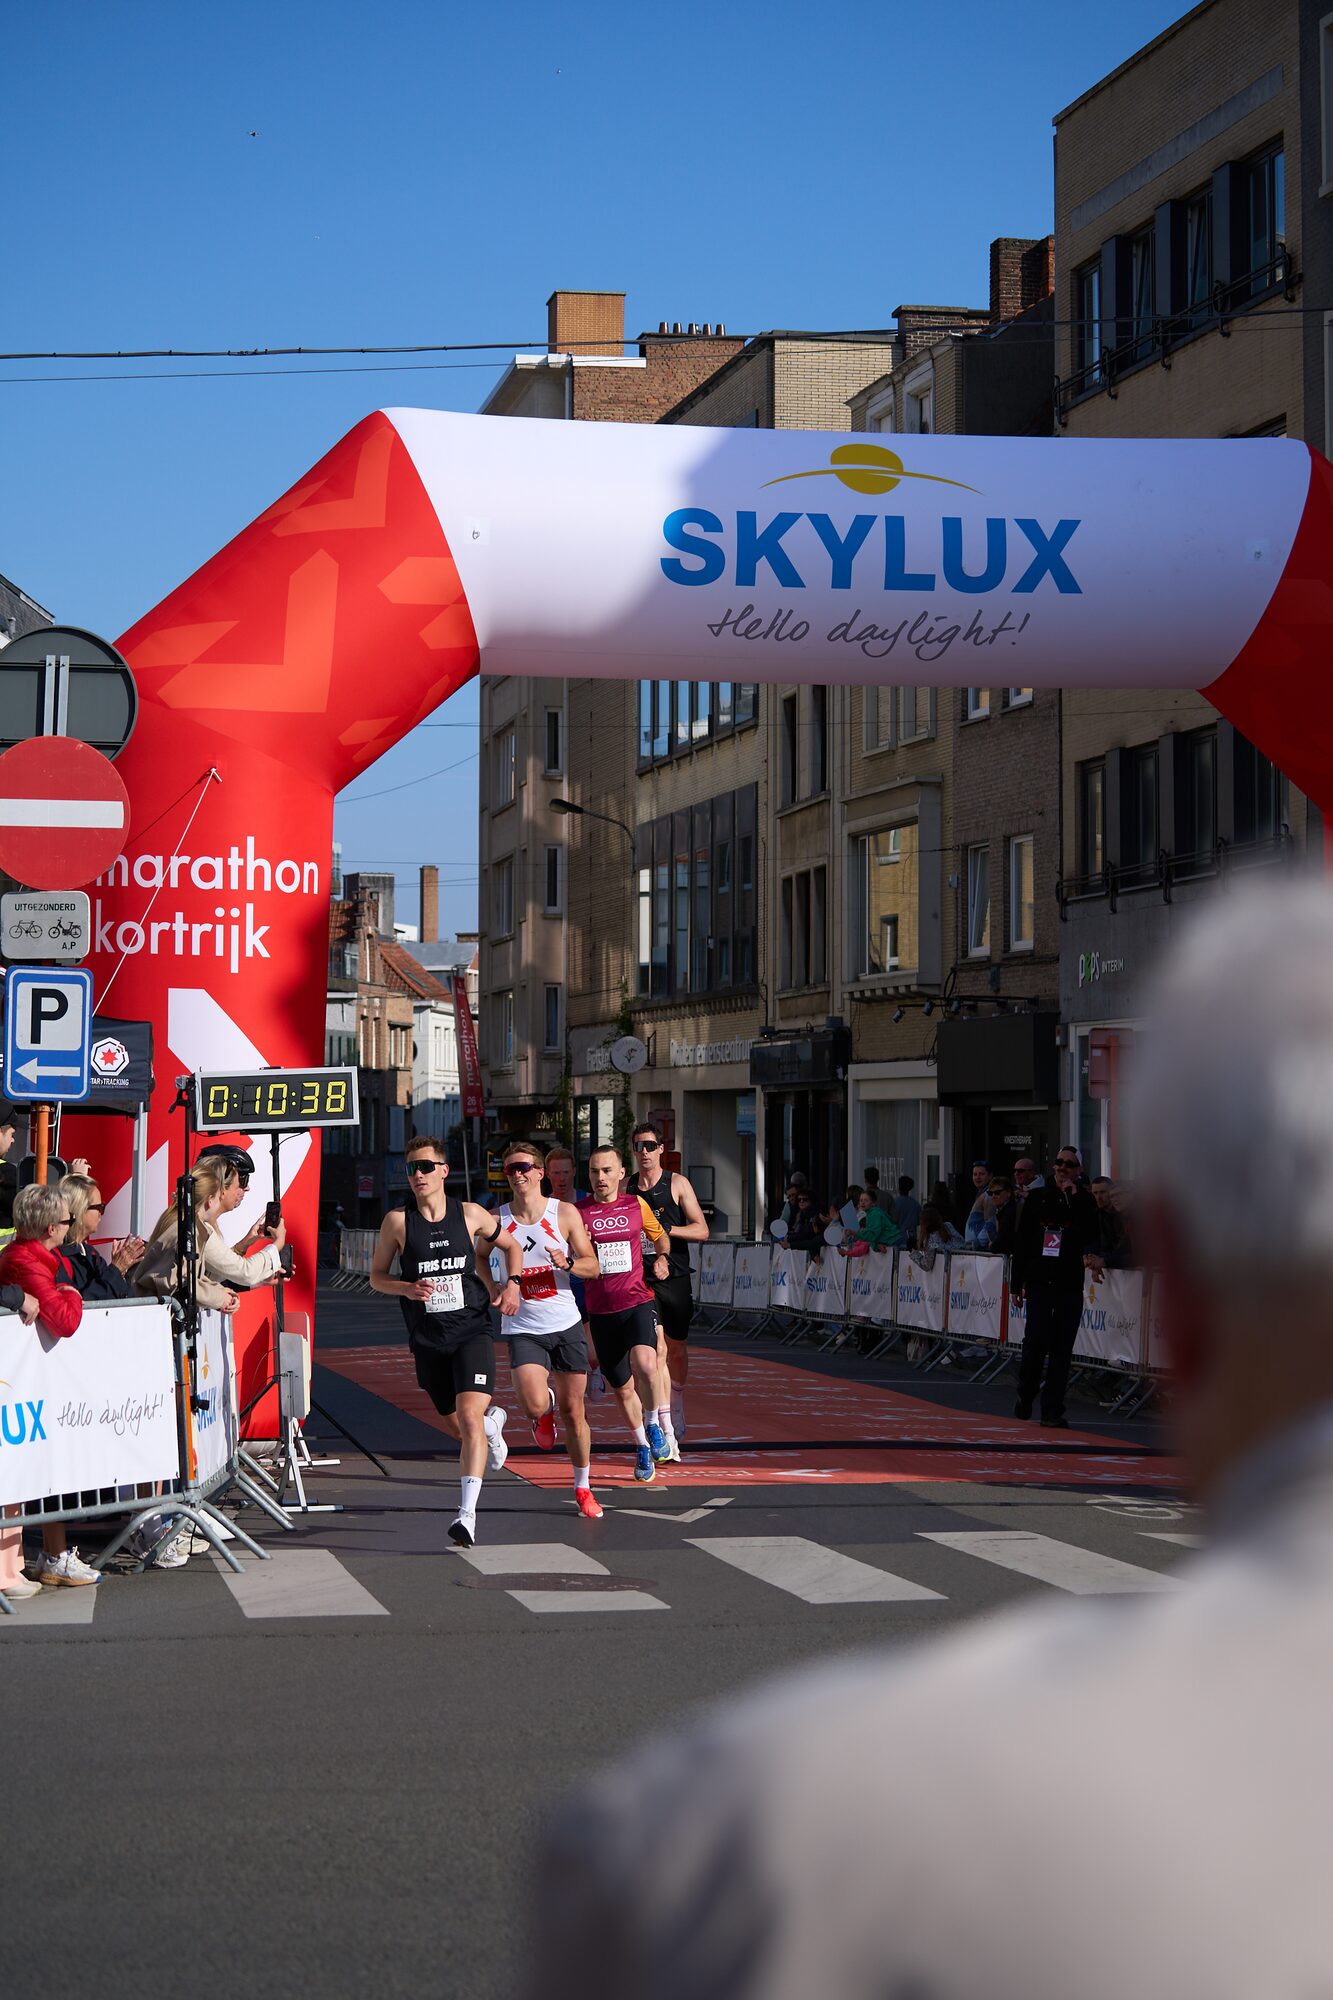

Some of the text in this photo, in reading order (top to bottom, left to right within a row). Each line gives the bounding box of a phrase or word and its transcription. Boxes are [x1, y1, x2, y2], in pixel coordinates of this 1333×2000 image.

[659, 507, 1083, 594] SKYLUX
[707, 604, 1031, 661] Hello daylight!
[96, 836, 319, 895] marathon
[15, 903, 76, 911] UITGEZONDERD
[95, 899, 271, 974] kortrijk
[30, 987, 69, 1045] P
[208, 1081, 347, 1118] 0:10:38
[418, 1260, 440, 1274] FRIS
[603, 1259, 627, 1268] Jonas
[431, 1293, 457, 1305] Emile
[526, 1284, 551, 1295] Milan
[1080, 1308, 1106, 1332] KYLUX
[1, 1394, 164, 1447] UX Hello daylight!
